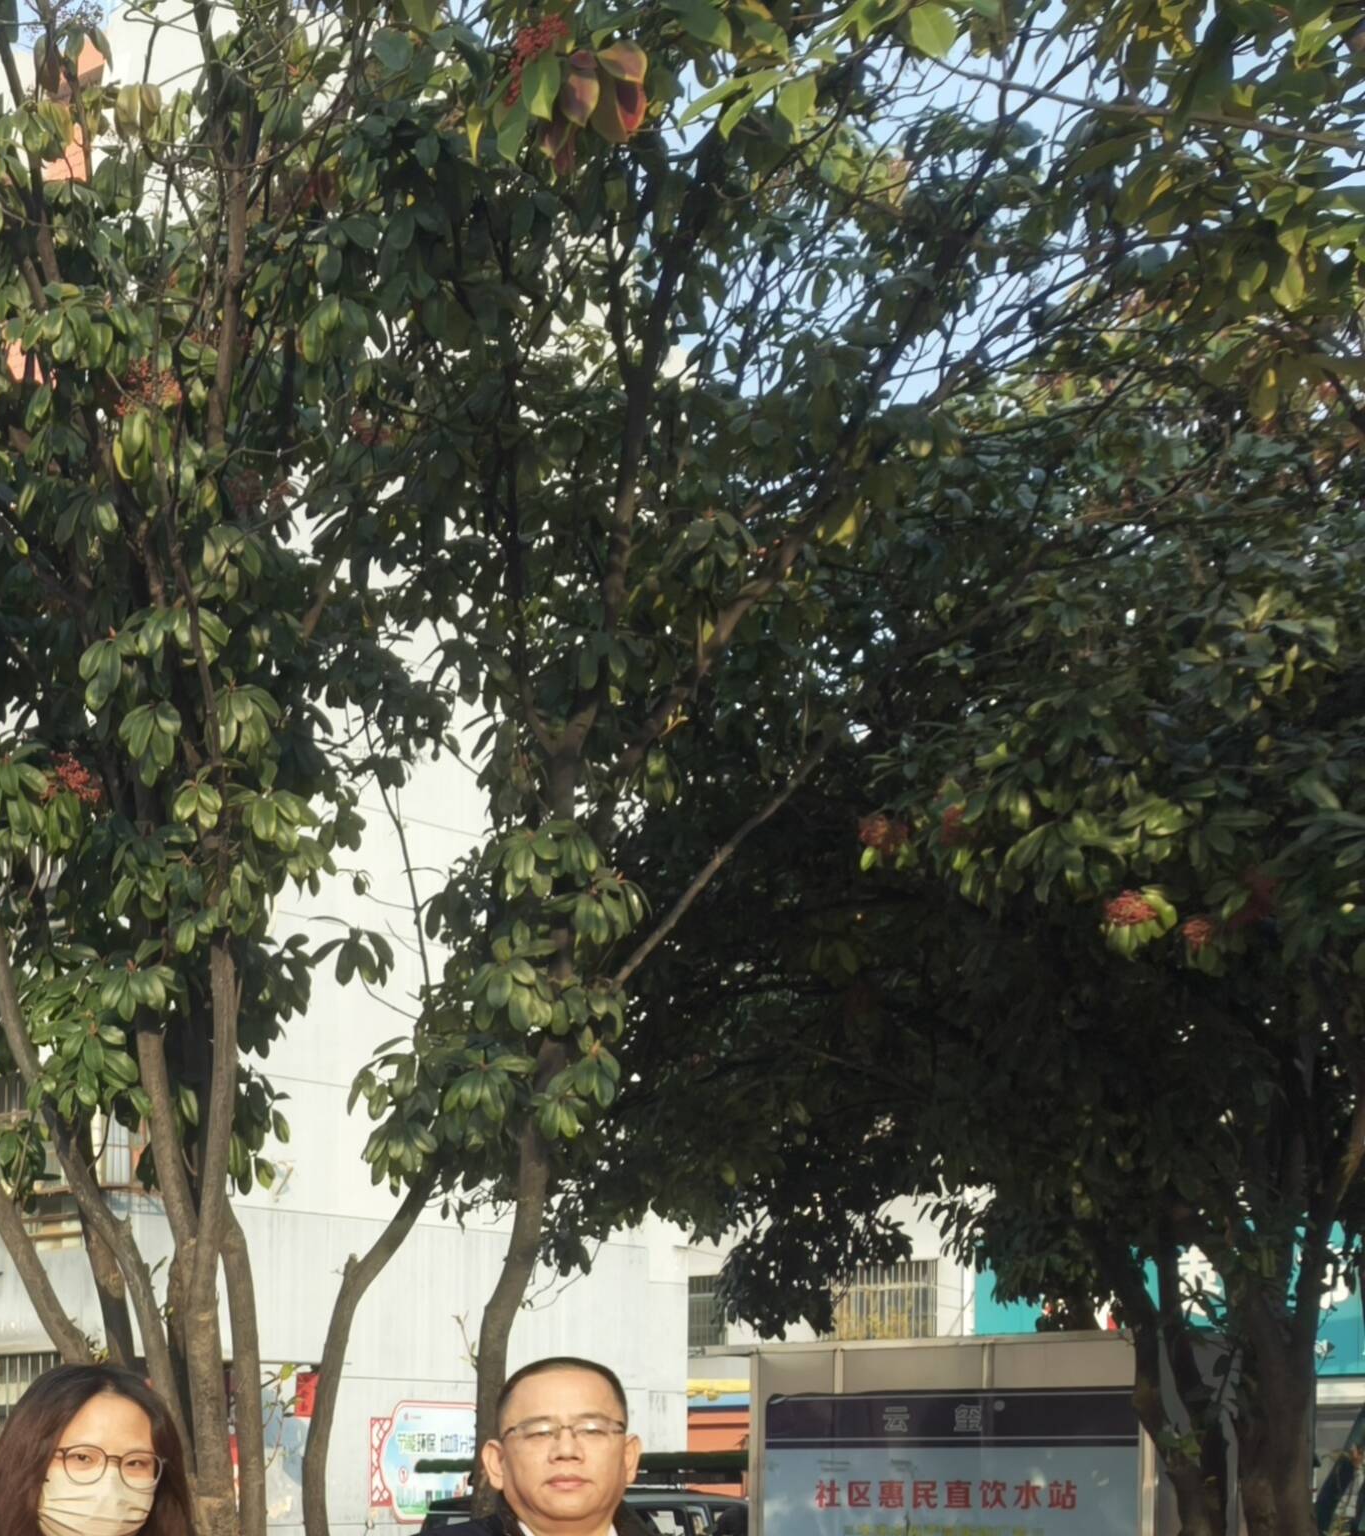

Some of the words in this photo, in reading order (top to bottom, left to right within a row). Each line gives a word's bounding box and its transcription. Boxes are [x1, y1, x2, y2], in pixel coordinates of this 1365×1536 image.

[814, 1479, 1078, 1511] 社区惠民直饮水站
